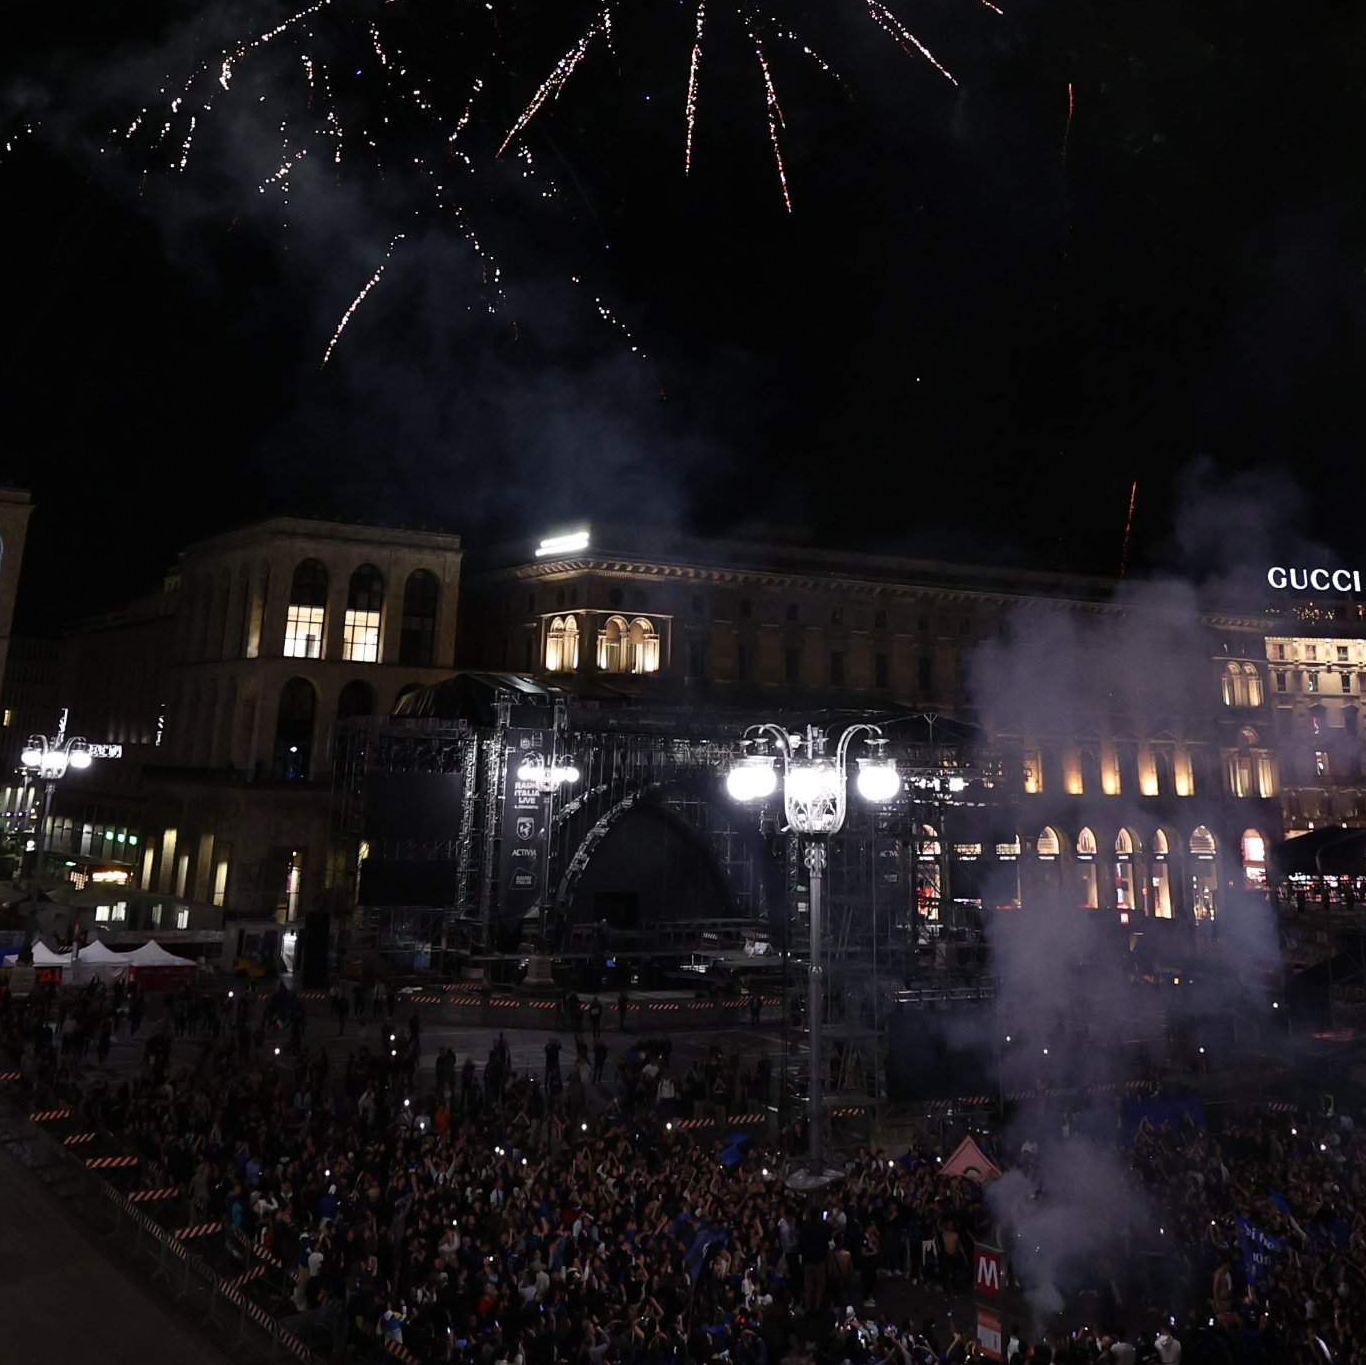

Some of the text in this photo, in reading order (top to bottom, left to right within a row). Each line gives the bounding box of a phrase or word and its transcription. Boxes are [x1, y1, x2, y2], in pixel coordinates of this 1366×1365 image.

[1267, 566, 1362, 593] GUCCI
[514, 789, 540, 797] ITALIA
[518, 796, 536, 804] LIVE
[977, 1255, 1000, 1290] M
